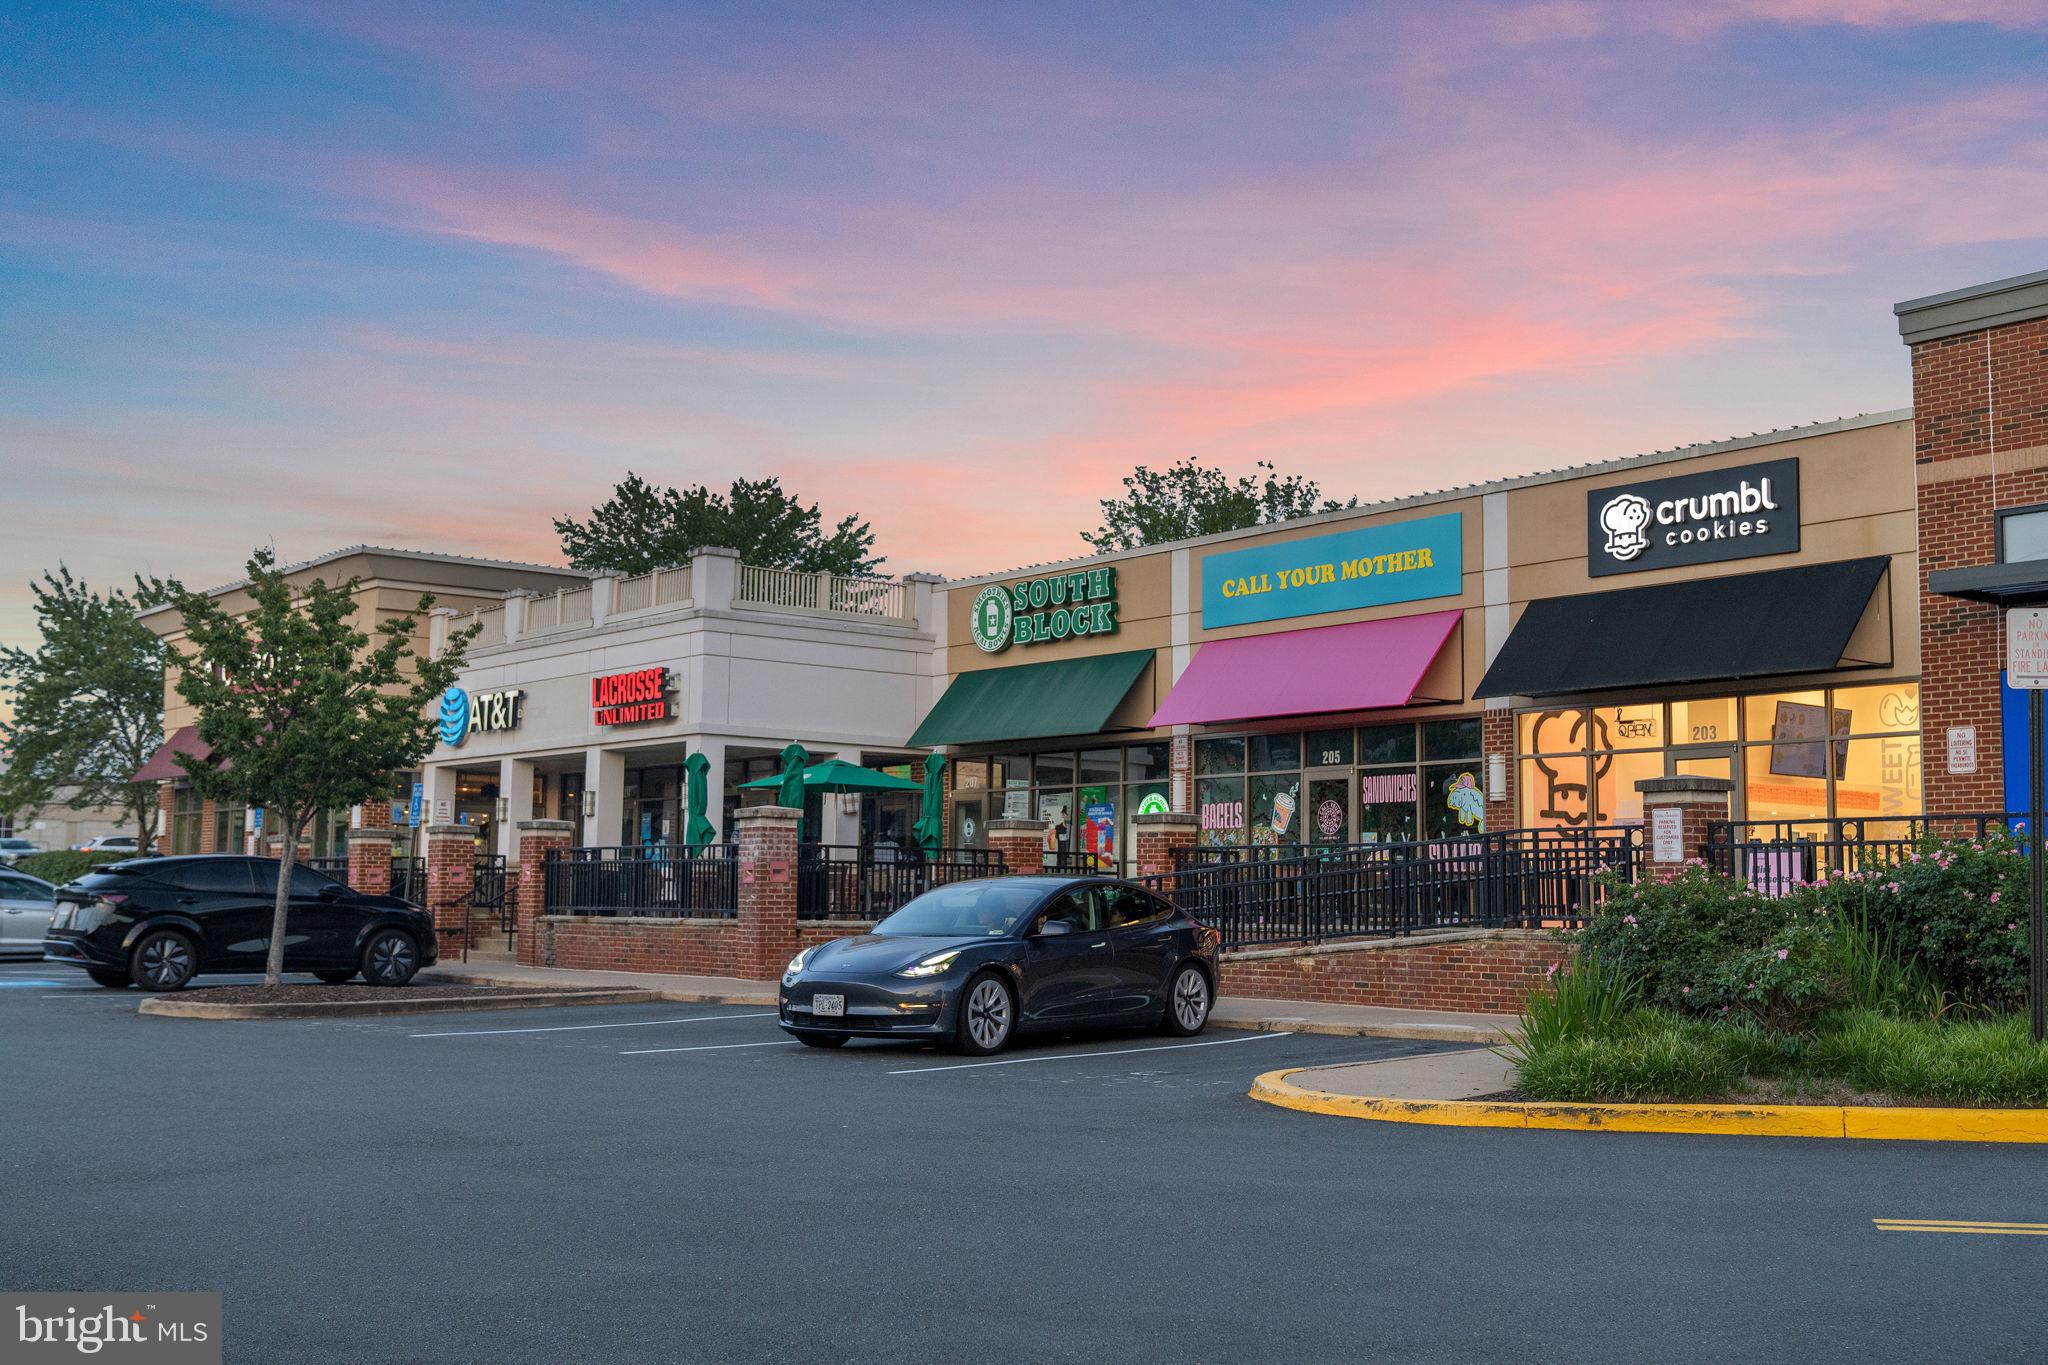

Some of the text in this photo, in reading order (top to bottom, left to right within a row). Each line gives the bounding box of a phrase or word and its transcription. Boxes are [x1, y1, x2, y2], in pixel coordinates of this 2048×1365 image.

[1656, 477, 1778, 524] crumbl
[1666, 519, 1768, 546] cookies
[1222, 548, 1434, 599] CALL YOUR MOTHER
[974, 588, 1010, 613] SMOOTHIES
[1013, 567, 1110, 612] SOUTH
[987, 622, 1009, 649] BOWLS
[1013, 602, 1112, 645] BLOCK
[2016, 631, 2048, 640] PARKIN
[2028, 618, 2043, 629] NO
[2012, 660, 2048, 673] FIRE LA
[2015, 648, 2048, 659] STANDI
[592, 667, 664, 708] LACROSSE
[467, 689, 520, 733] AT&T
[594, 701, 665, 727] UNLIMITED
[1692, 725, 1717, 741] 203
[1322, 750, 1341, 764] 205
[965, 776, 978, 789] 207
[1362, 774, 1417, 804] SANDWICHES
[1881, 739, 1903, 822] WEET
[1201, 802, 1243, 830] BAGELS
